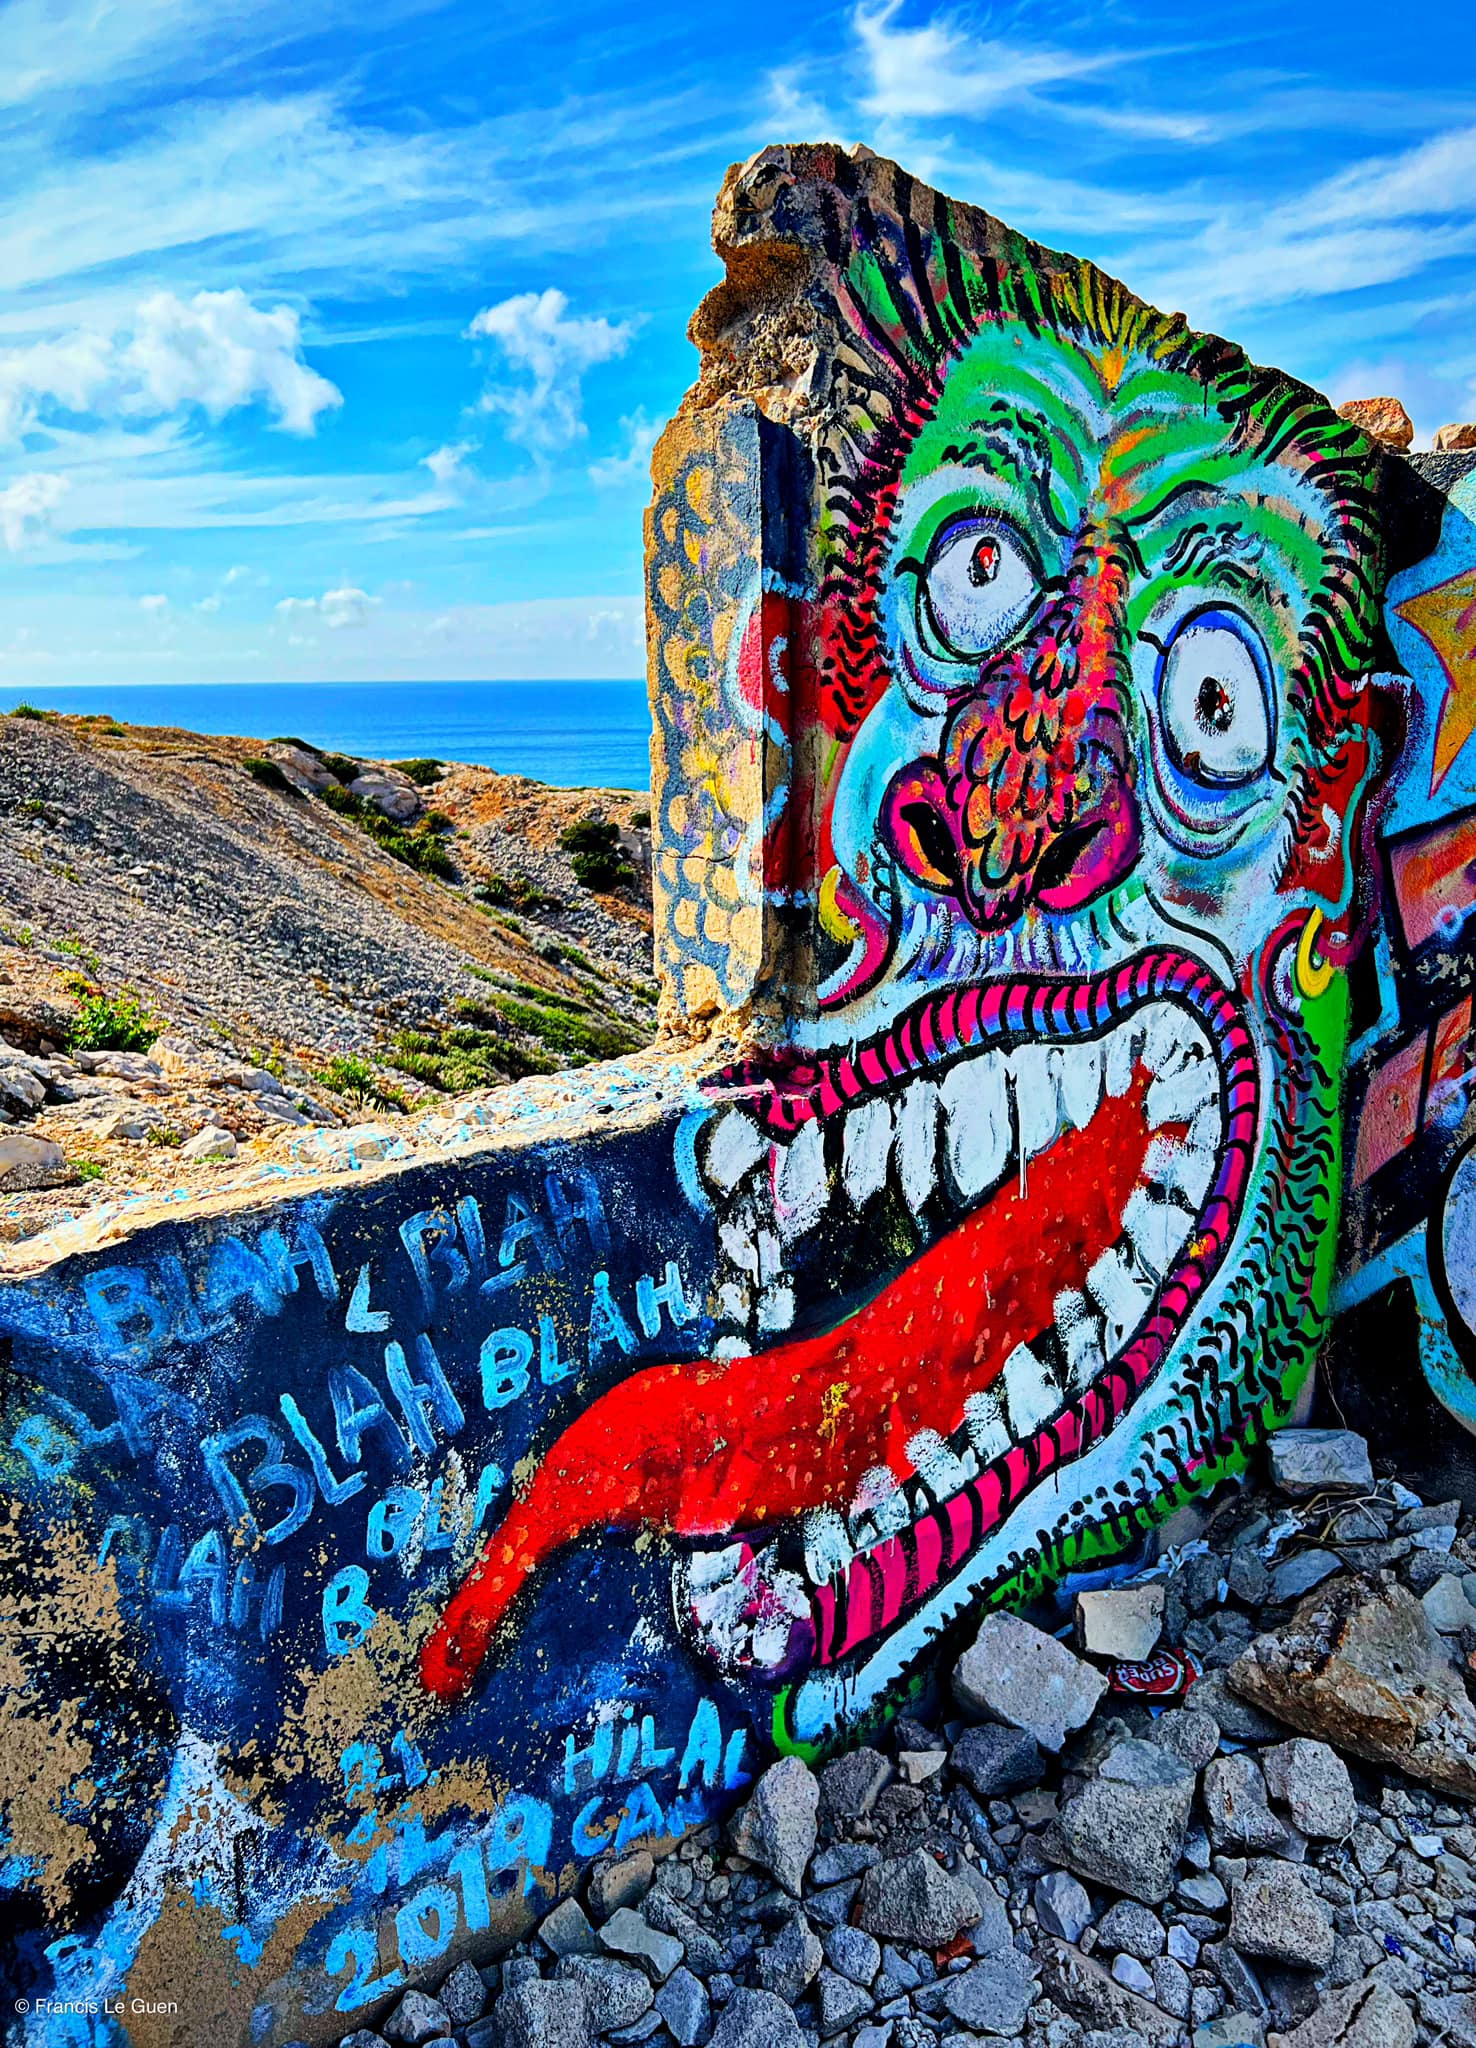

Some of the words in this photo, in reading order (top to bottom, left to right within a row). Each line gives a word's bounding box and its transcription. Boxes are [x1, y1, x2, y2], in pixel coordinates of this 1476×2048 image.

[399, 1167, 612, 1312] BLAH
[199, 1332, 466, 1547] BLAH
[480, 1259, 693, 1411] BLAH
[1115, 1664, 1175, 1682] SUPER
[324, 1791, 553, 2013] 2019
